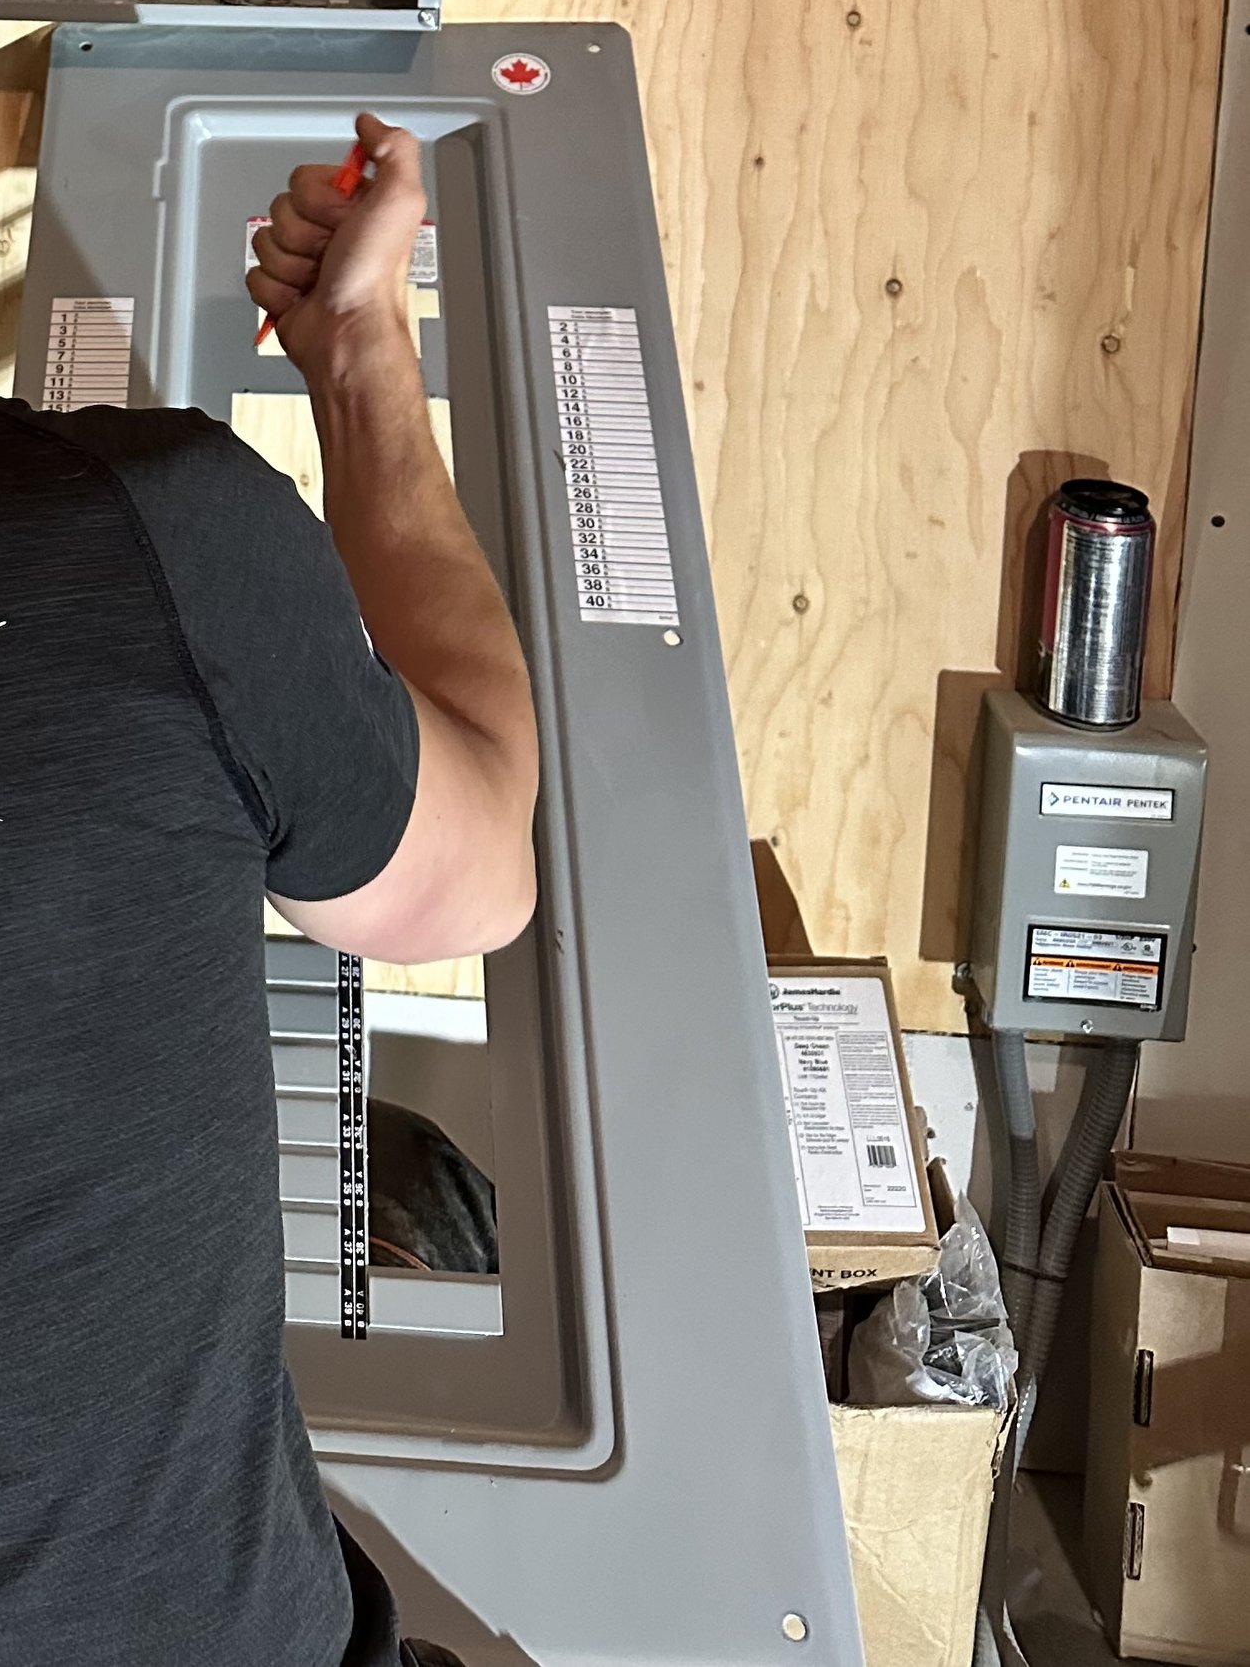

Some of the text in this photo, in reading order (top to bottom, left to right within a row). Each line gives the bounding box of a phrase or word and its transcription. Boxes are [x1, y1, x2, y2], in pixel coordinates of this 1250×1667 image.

[62, 314, 67, 322] 1
[59, 326, 67, 335] 3
[559, 322, 568, 332] 2
[58, 339, 66, 348] 5
[561, 335, 569, 344] 4
[57, 351, 65, 360] 7
[562, 348, 571, 358] 6
[56, 364, 64, 374] 9
[564, 361, 573, 371] 8
[50, 378, 64, 386] 11
[561, 375, 577, 385] 10
[49, 391, 65, 400] 13
[561, 389, 578, 399] 12
[564, 402, 581, 412] 14
[565, 416, 582, 426] 16
[567, 430, 584, 441] 18
[569, 444, 587, 455] 20
[571, 458, 588, 470] 22
[572, 473, 590, 484] 24
[574, 487, 592, 498] 26
[575, 502, 594, 513] 28
[577, 517, 595, 528] 30
[578, 533, 597, 544] 32
[580, 548, 599, 560] 34
[581, 563, 600, 575] 36
[584, 579, 603, 591] 38
[586, 595, 605, 607] 40
[1063, 795, 1168, 809] PENTAIR PENTEK
[341, 966, 349, 977] 27
[782, 987, 841, 995] JamesHardie
[807, 1002, 858, 1015] Technology
[342, 1017, 349, 1029] 29
[353, 1018, 361, 1029] 30
[342, 1070, 350, 1081] 31
[343, 1126, 351, 1137] 33
[343, 1182, 352, 1195] 35
[355, 1183, 364, 1195] 36
[344, 1241, 353, 1253] 37
[356, 1242, 364, 1254] 38
[840, 1267, 878, 1280] BOX
[344, 1302, 353, 1315] 39
[356, 1303, 365, 1315] 40
